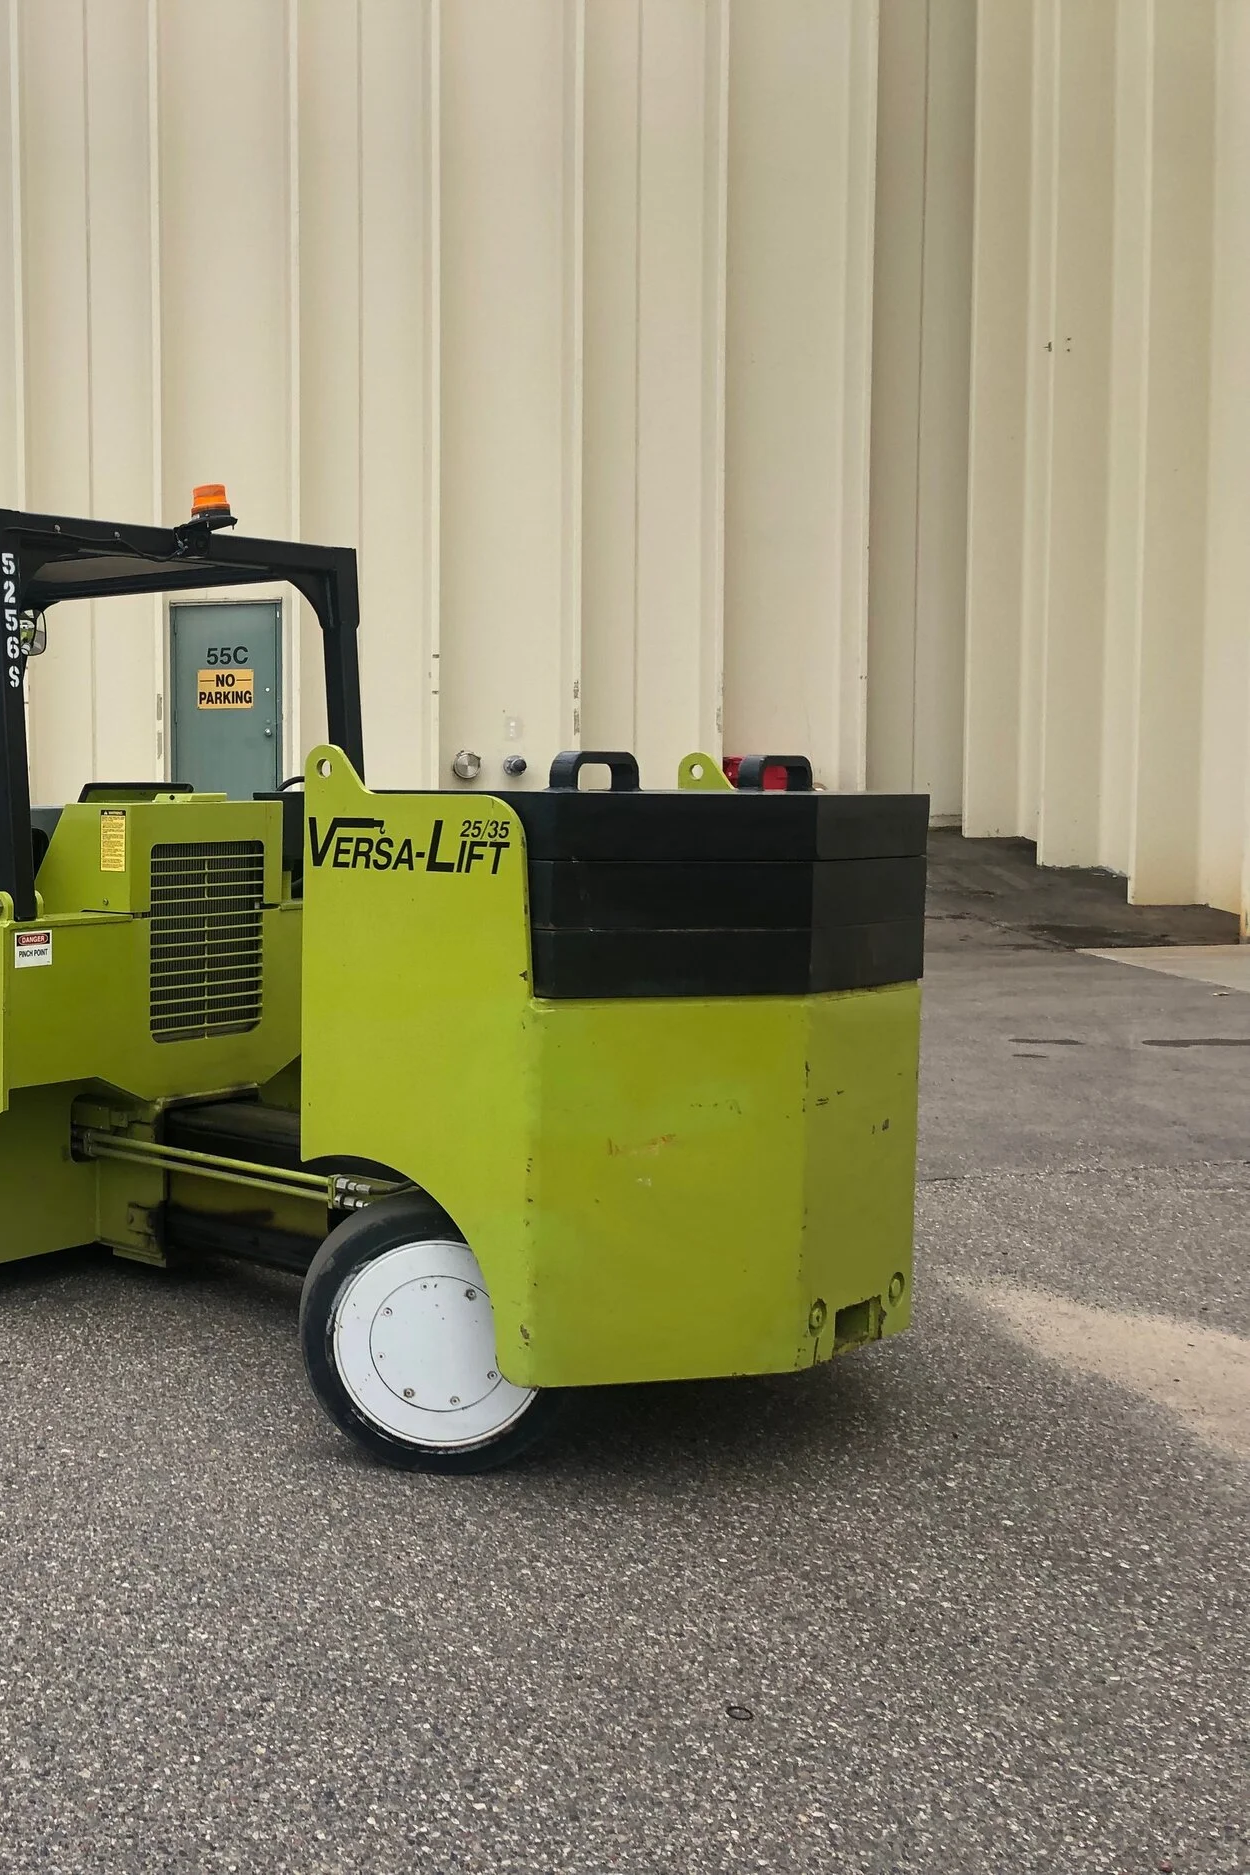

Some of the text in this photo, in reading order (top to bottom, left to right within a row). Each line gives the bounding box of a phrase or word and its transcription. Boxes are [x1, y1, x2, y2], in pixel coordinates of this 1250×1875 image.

[206, 645, 249, 666] 55C
[215, 673, 236, 688] NO
[198, 690, 253, 705] PARKING
[459, 819, 510, 840] 25/35
[308, 817, 511, 875] VERSA-LIFT
[21, 935, 45, 944] DANGER
[18, 948, 48, 958] PINCH POINT
